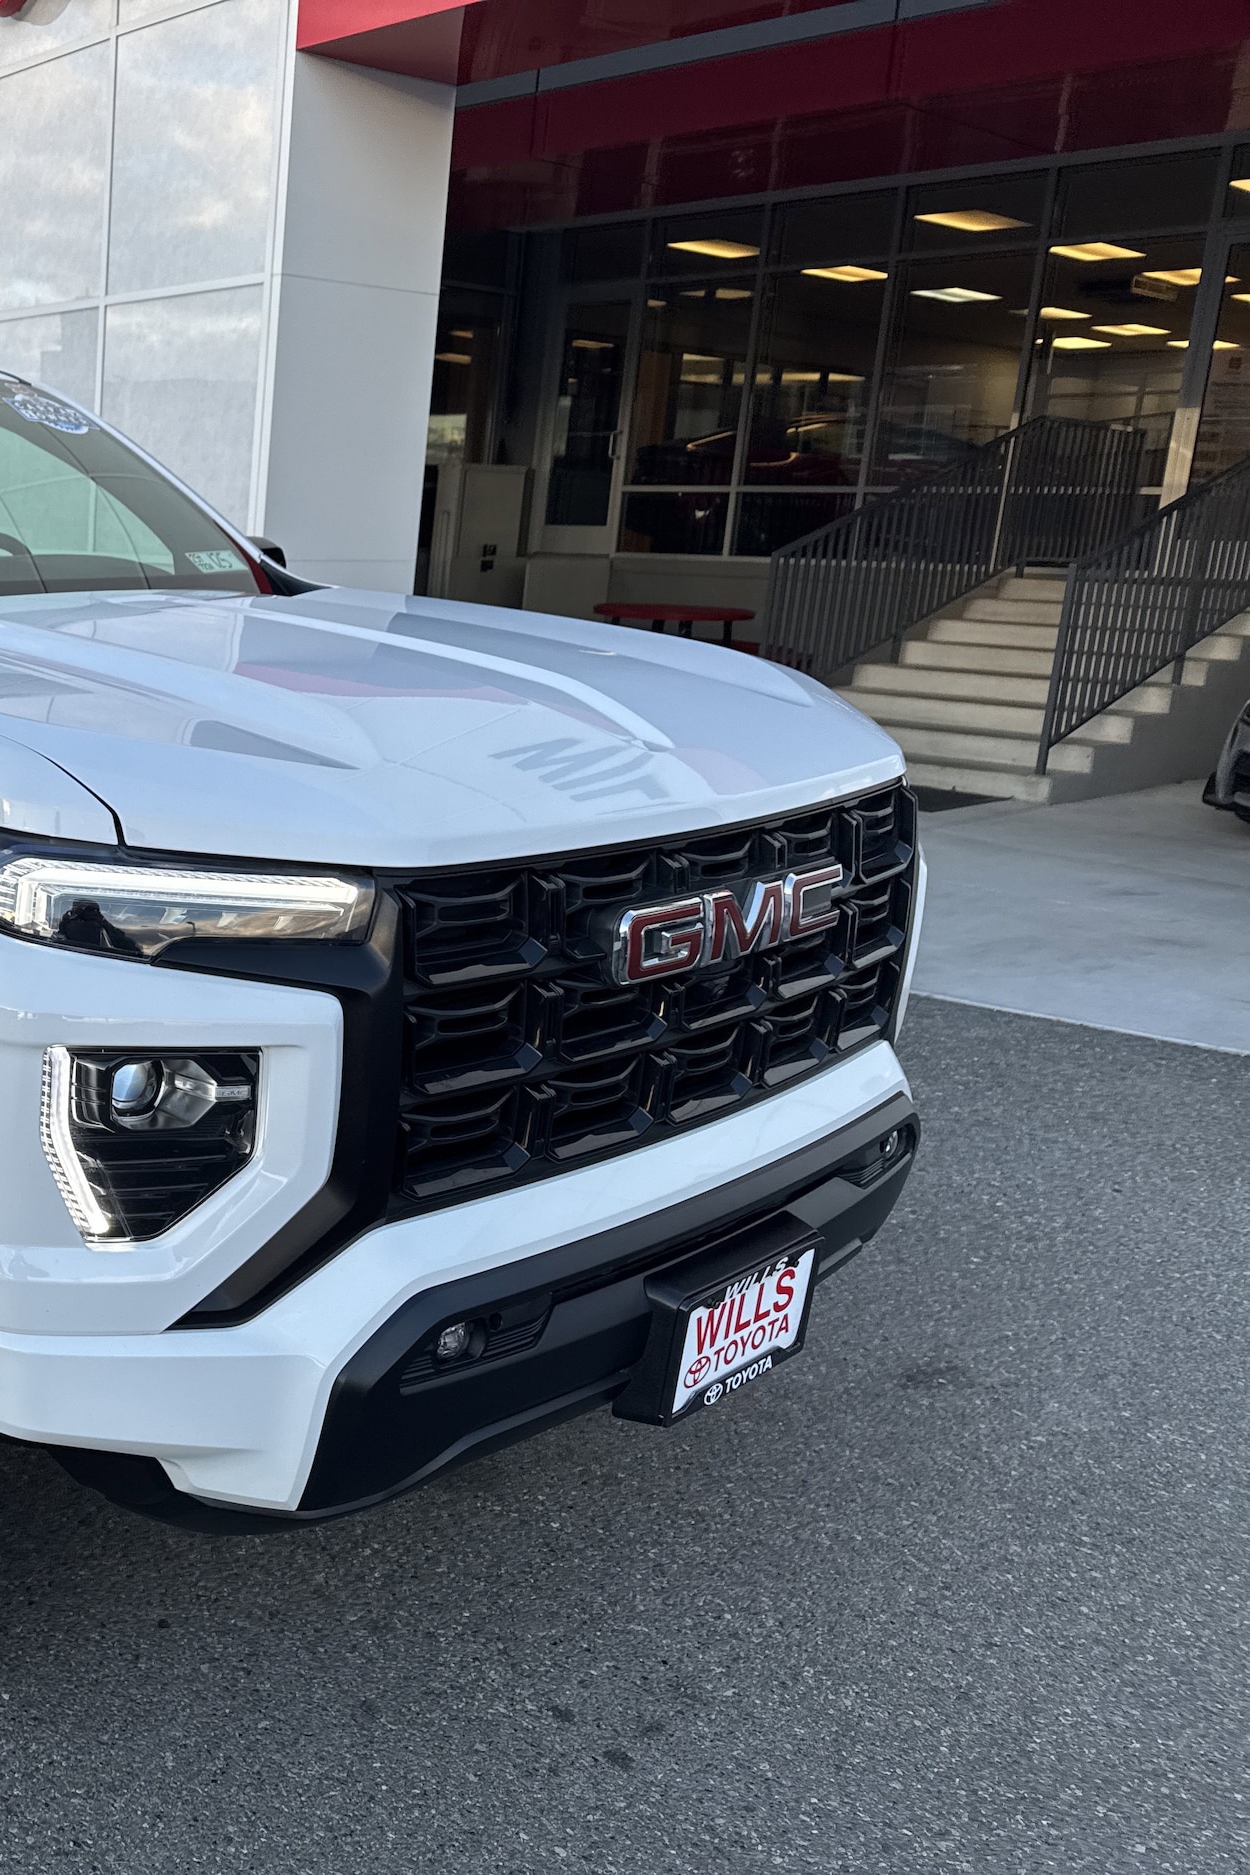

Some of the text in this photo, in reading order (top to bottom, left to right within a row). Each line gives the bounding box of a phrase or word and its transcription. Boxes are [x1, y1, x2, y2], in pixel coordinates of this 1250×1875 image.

[613, 863, 843, 986] GMC
[696, 1268, 796, 1356] WILLS
[713, 1312, 790, 1372] TOYOTA
[726, 1355, 773, 1394] TOYOTA
